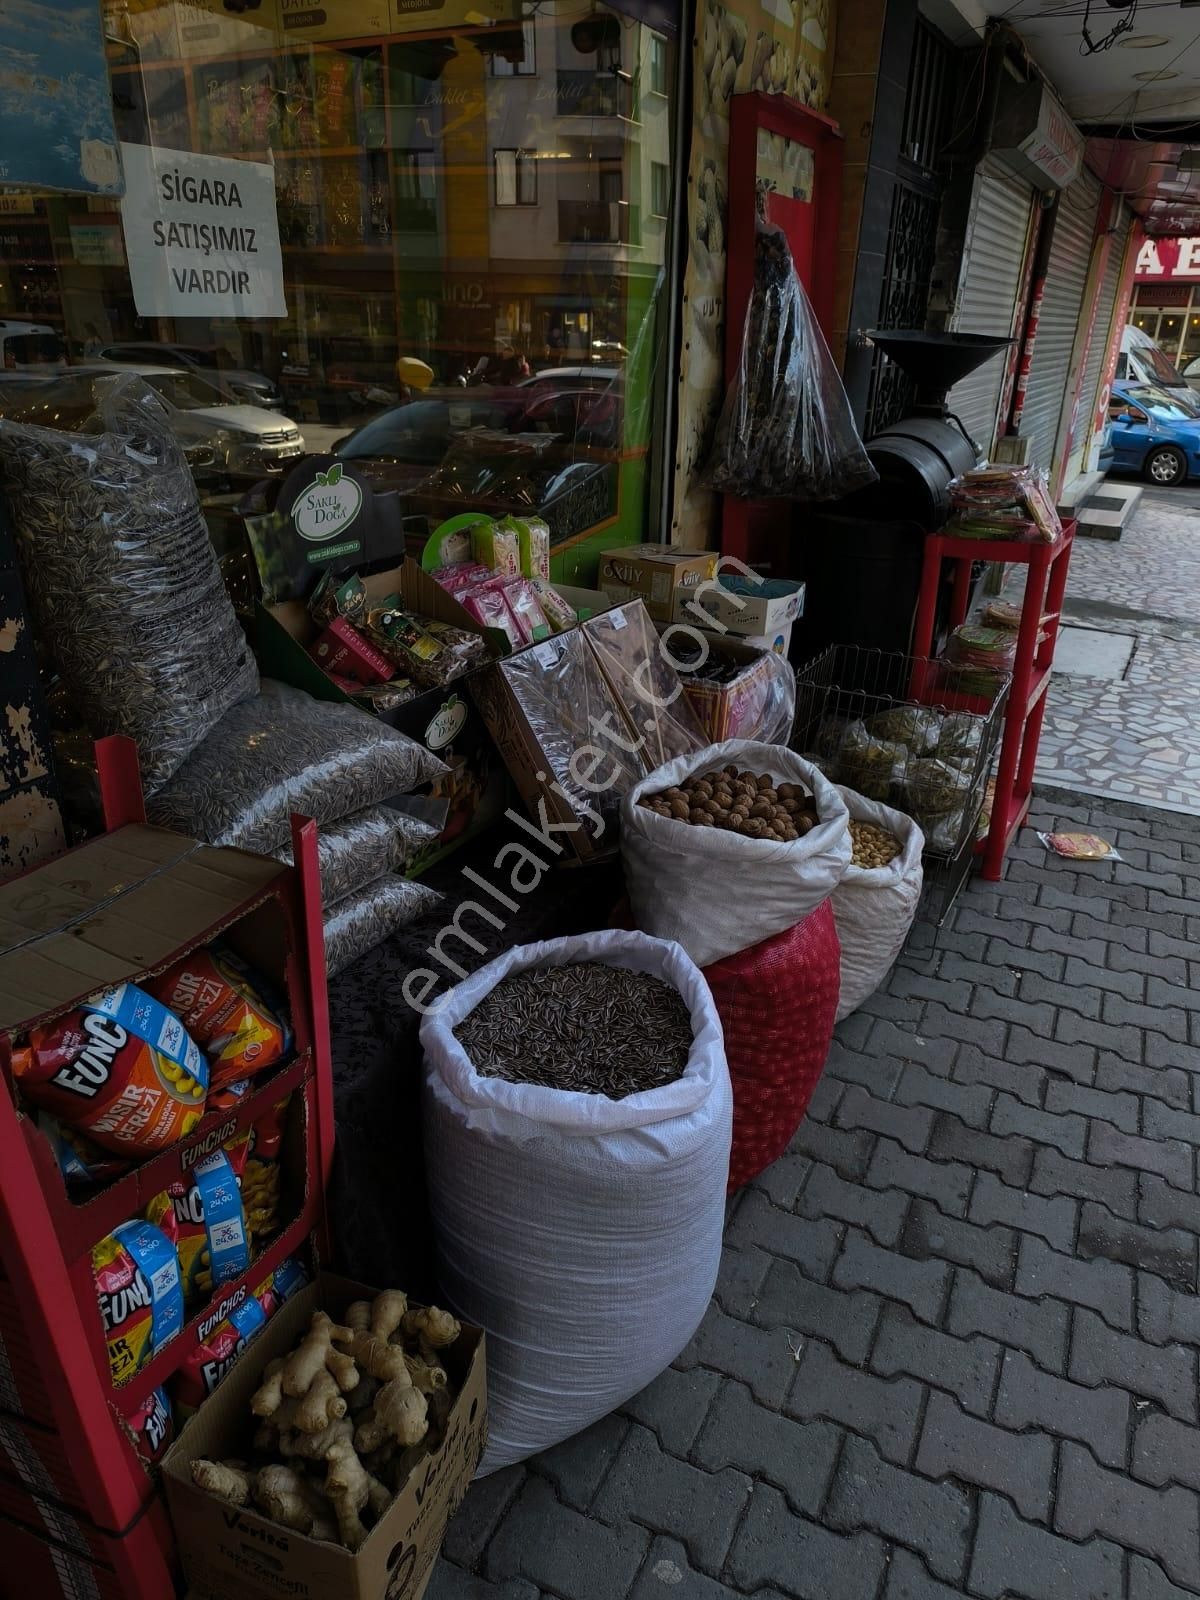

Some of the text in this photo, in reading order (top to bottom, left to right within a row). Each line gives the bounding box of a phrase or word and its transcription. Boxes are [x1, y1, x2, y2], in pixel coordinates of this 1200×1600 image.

[161, 168, 243, 208] SİGARA
[153, 220, 257, 256] SATIŞIMIZ
[172, 268, 250, 294] VARDIR
[90, 1084, 147, 1134] MISIR
[114, 1087, 163, 1142] ÇEREZİ
[181, 1118, 238, 1172] FUNCHOS
[197, 1284, 247, 1342] FUNCHOS
